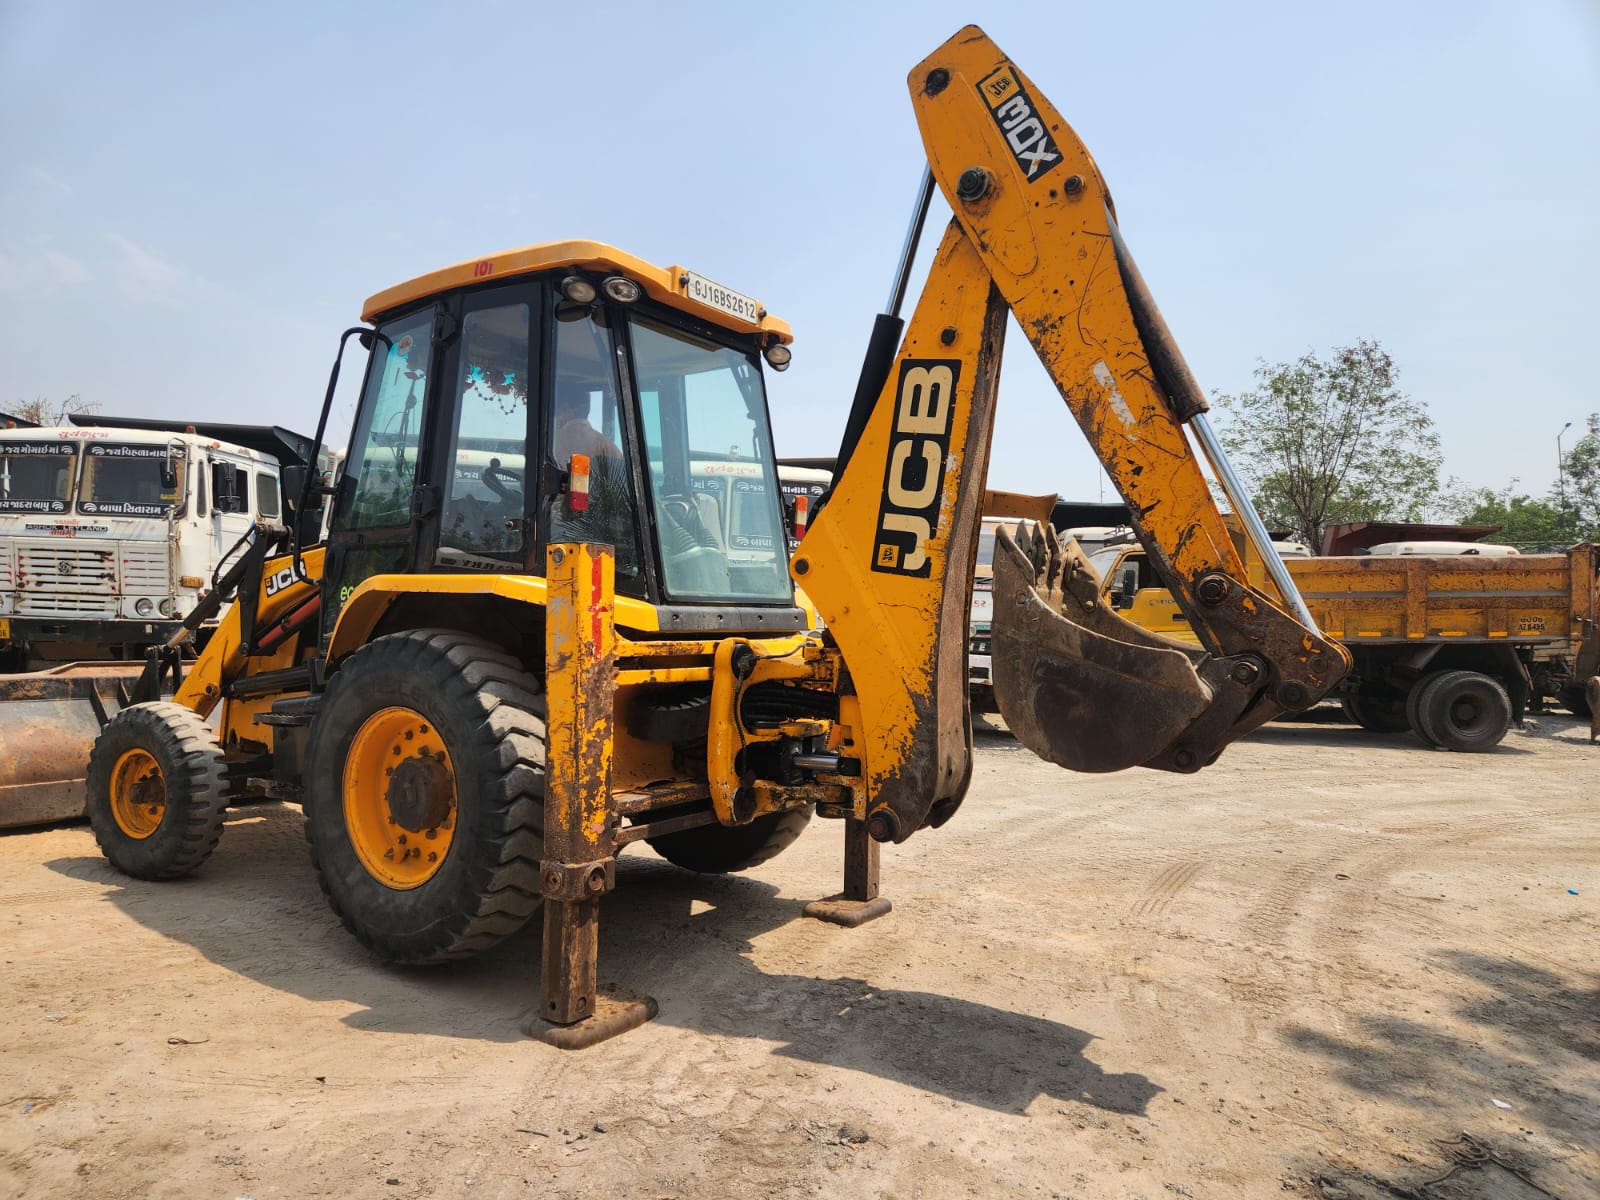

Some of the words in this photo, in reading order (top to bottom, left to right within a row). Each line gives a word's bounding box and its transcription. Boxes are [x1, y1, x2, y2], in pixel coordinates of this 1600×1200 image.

[997, 95, 1059, 177] 3DX
[695, 280, 756, 319] GJ16BS2612
[881, 365, 953, 571] JCB
